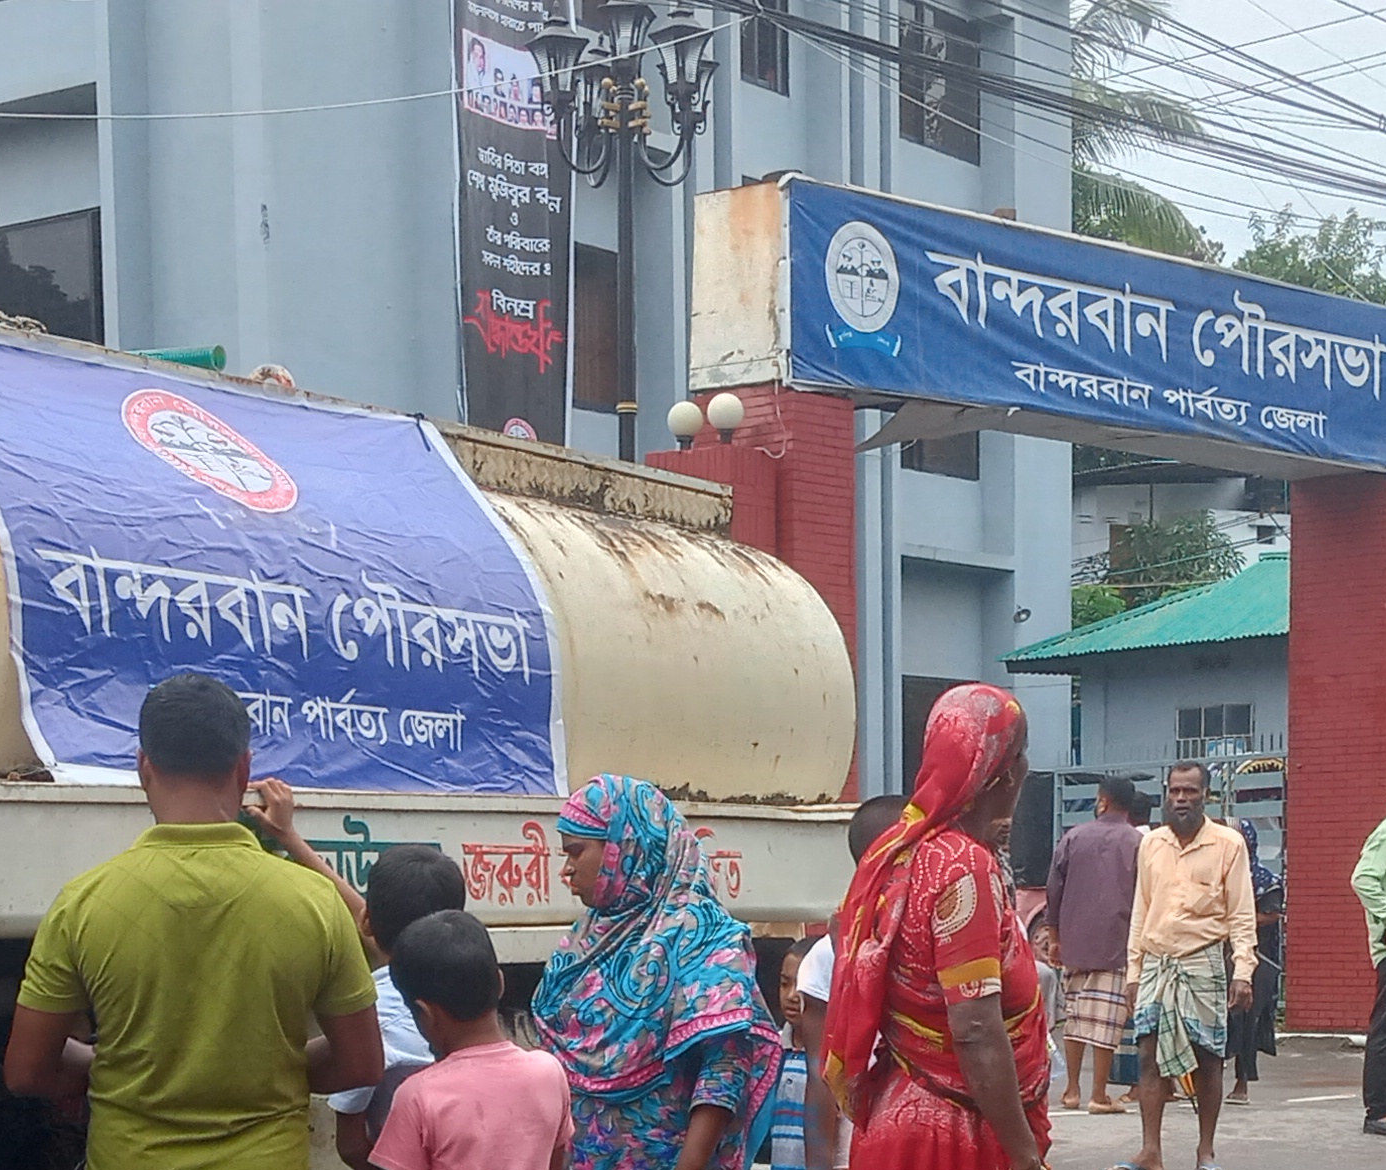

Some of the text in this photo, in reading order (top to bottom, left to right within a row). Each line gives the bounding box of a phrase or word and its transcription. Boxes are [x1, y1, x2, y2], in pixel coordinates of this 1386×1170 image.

[509, 212, 519, 225] ও
[491, 288, 536, 319] বিনম্র
[924, 250, 1177, 361] বান্দরবান
[1011, 360, 1329, 438] বান্দরবান পার্বত্য জেলা
[36, 546, 532, 686] বান্দরবান পৌরসভা
[301, 688, 389, 746] পার্বত্য
[400, 709, 466, 752] জেলা
[462, 820, 551, 906] জরুরী
